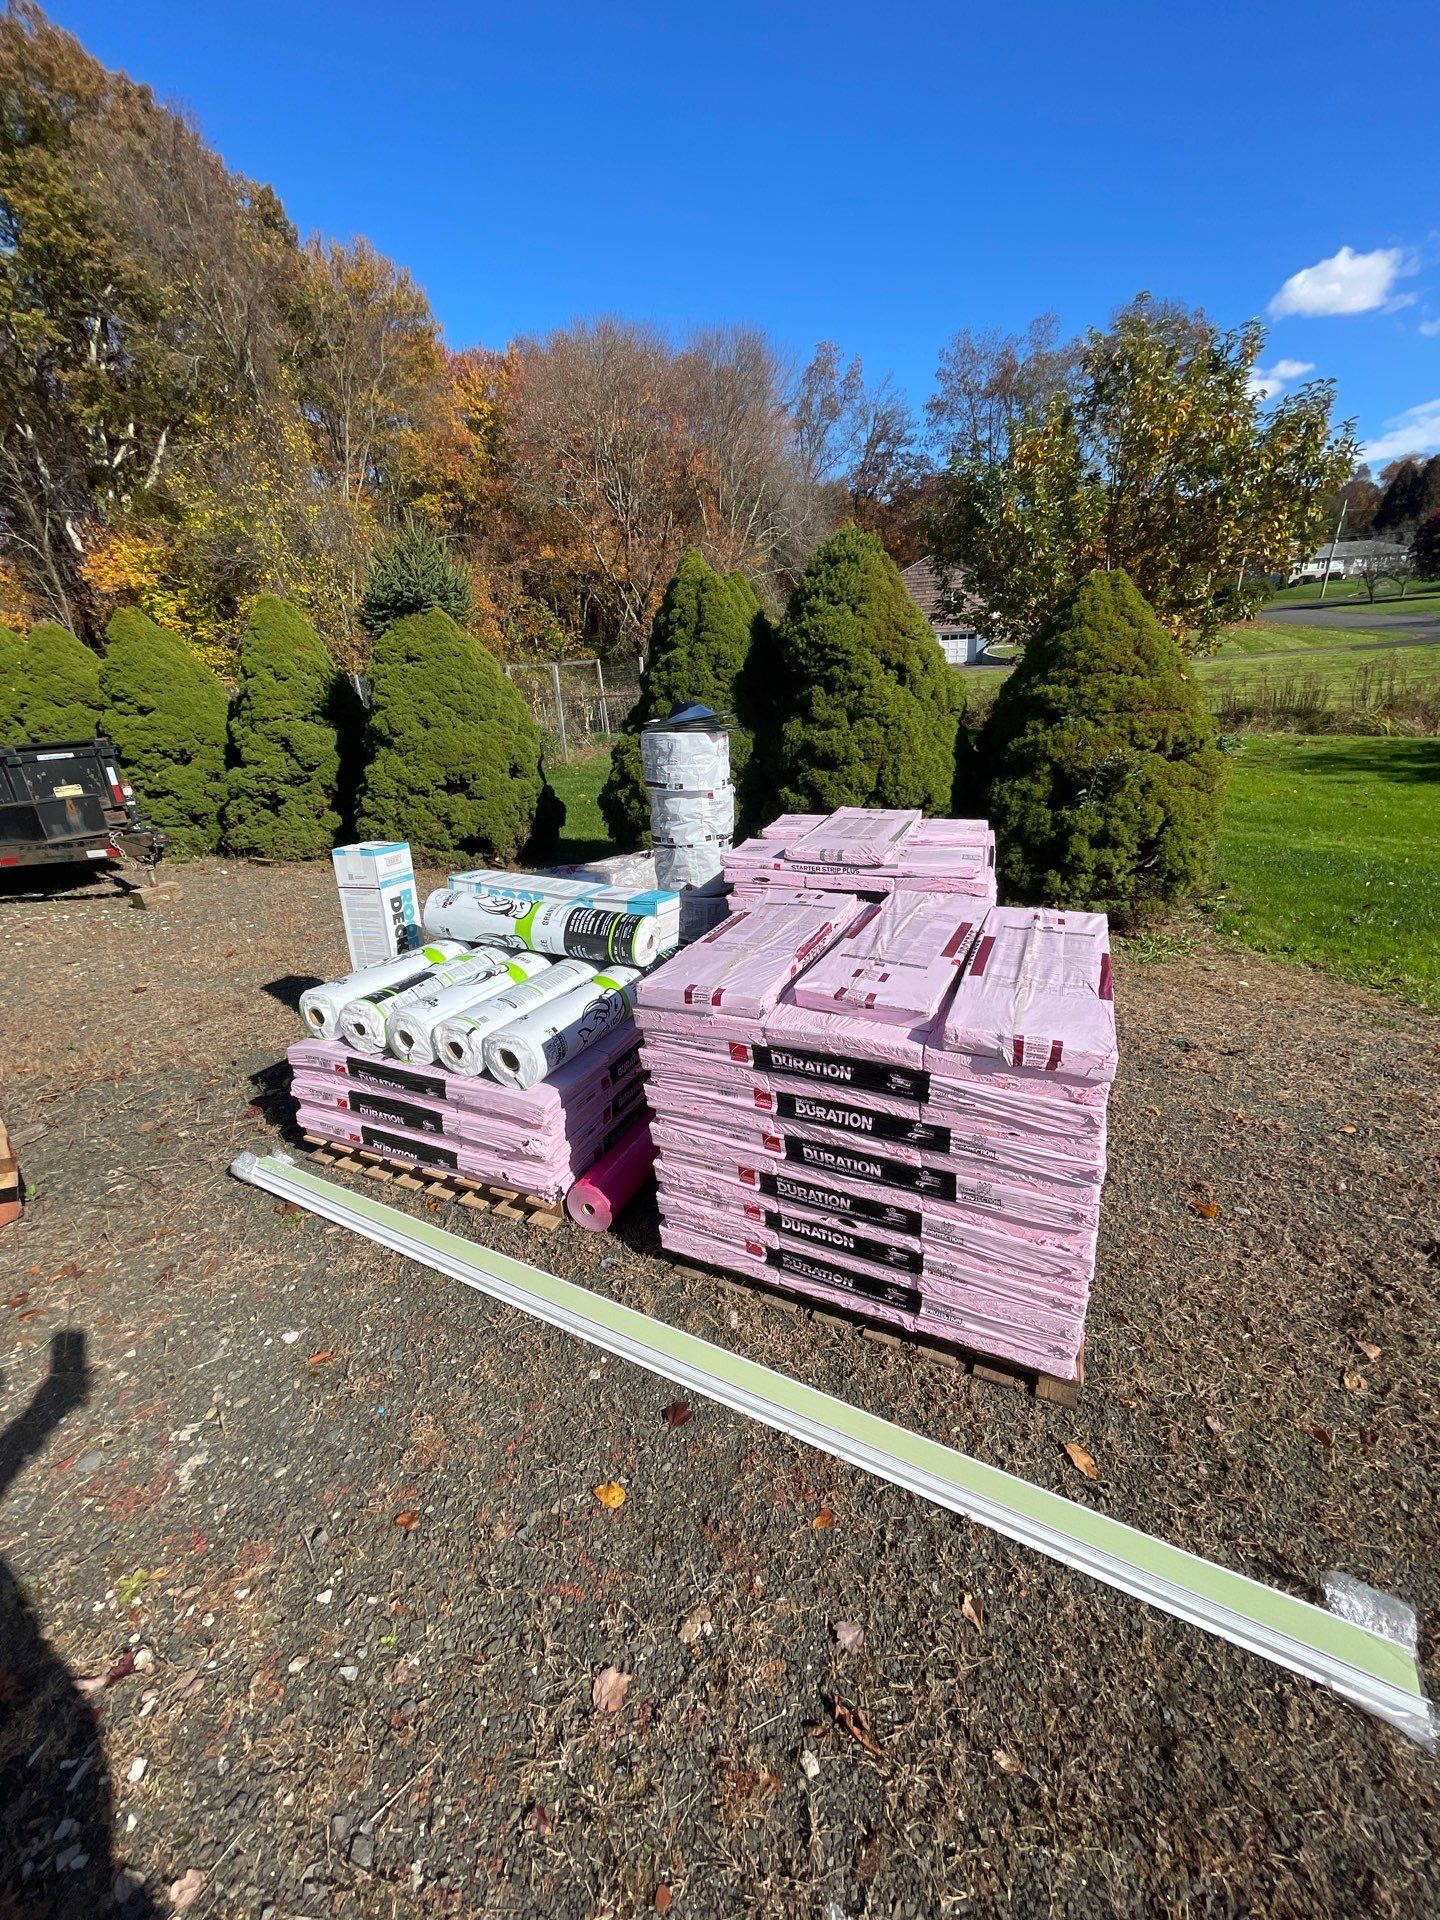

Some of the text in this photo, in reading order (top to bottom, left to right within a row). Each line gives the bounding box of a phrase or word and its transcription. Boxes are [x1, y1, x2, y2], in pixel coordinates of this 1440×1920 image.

[791, 864, 820, 872] STARTER
[390, 896, 410, 956] DECK
[771, 1053, 852, 1080] DURATION
[359, 1073, 405, 1090] DURATION
[360, 1107, 405, 1125] DURATION
[795, 1100, 874, 1131] DURATION
[373, 1142, 418, 1159] DURATION
[803, 1147, 882, 1178] DURATION
[777, 1182, 850, 1209] DURATION
[782, 1215, 854, 1248] DURATION
[783, 1256, 853, 1287] DURATION
